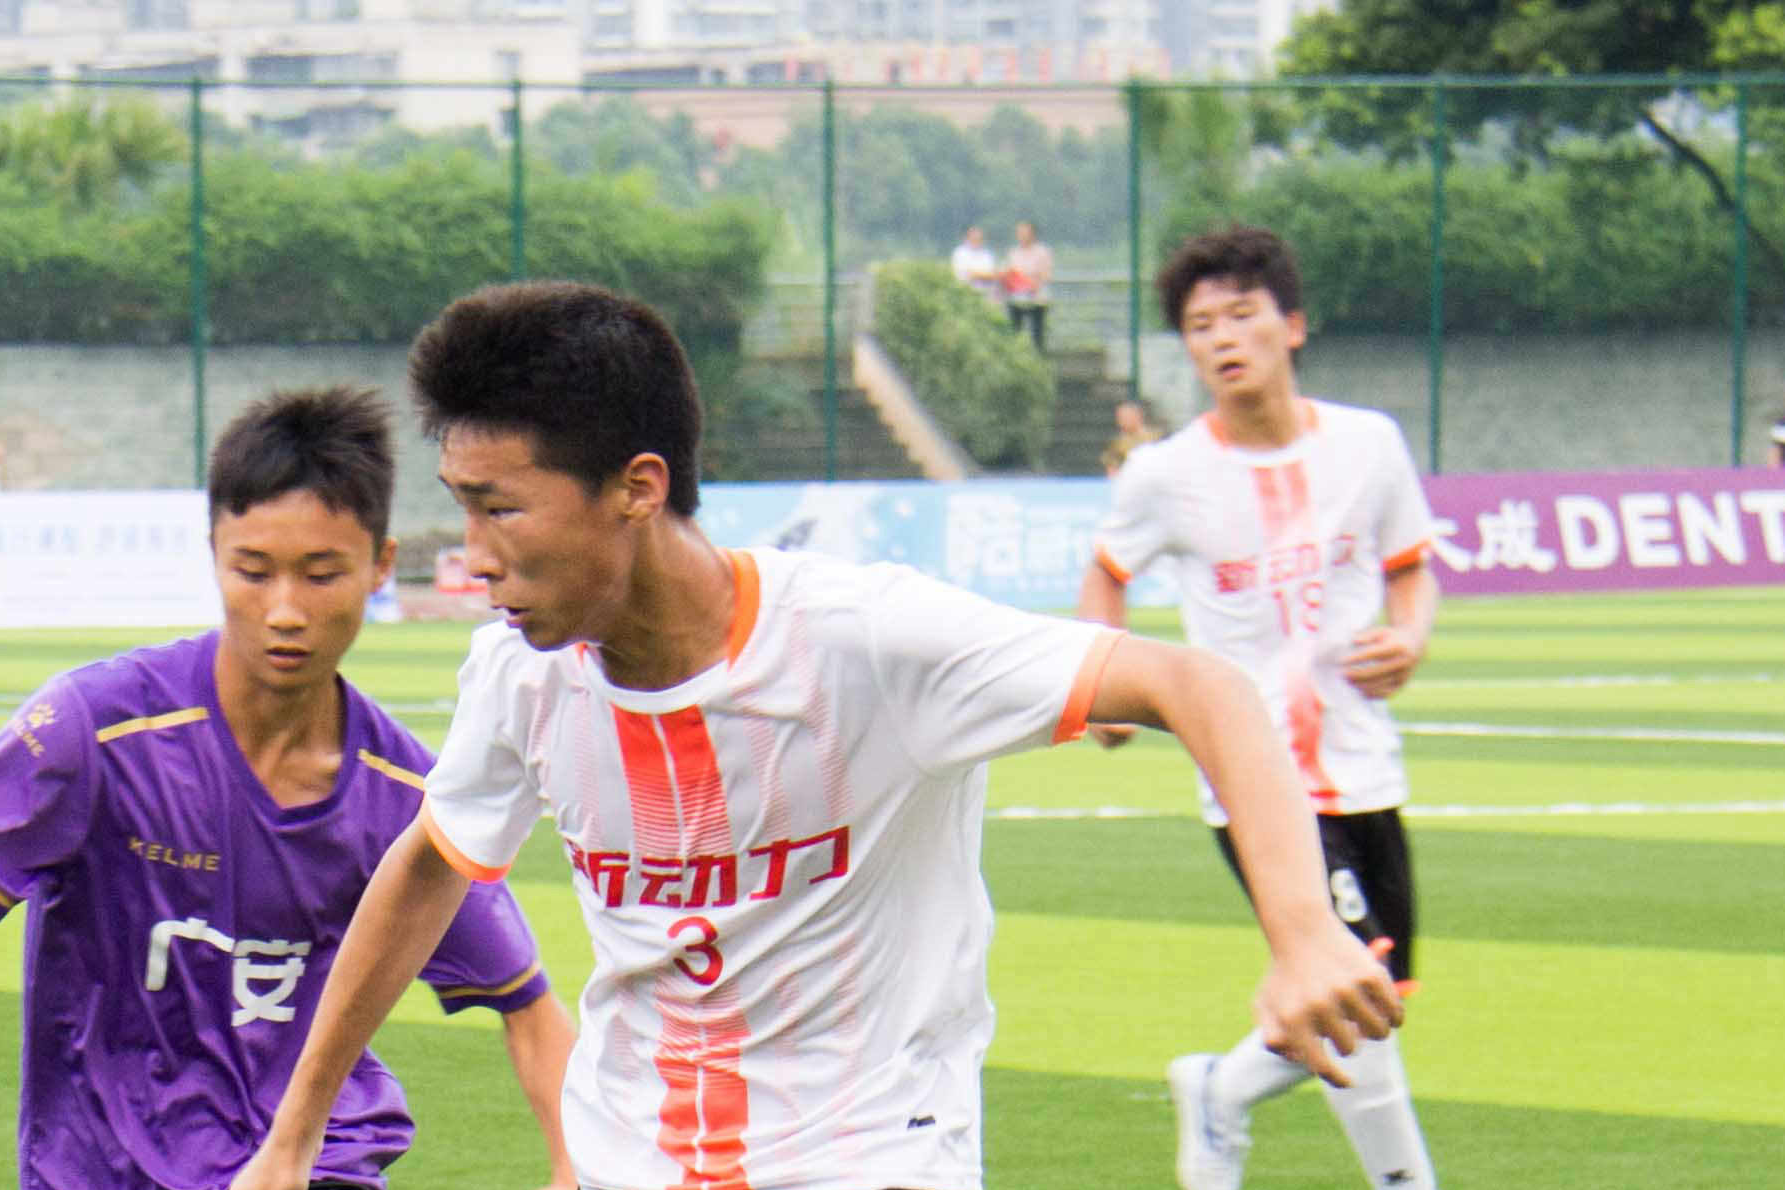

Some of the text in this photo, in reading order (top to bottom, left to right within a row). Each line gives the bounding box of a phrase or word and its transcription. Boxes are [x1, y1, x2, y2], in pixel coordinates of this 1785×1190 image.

[1552, 489, 1785, 569] DENT
[127, 836, 222, 872] KELME
[144, 916, 313, 1028] 广安
[666, 915, 725, 987] 3
